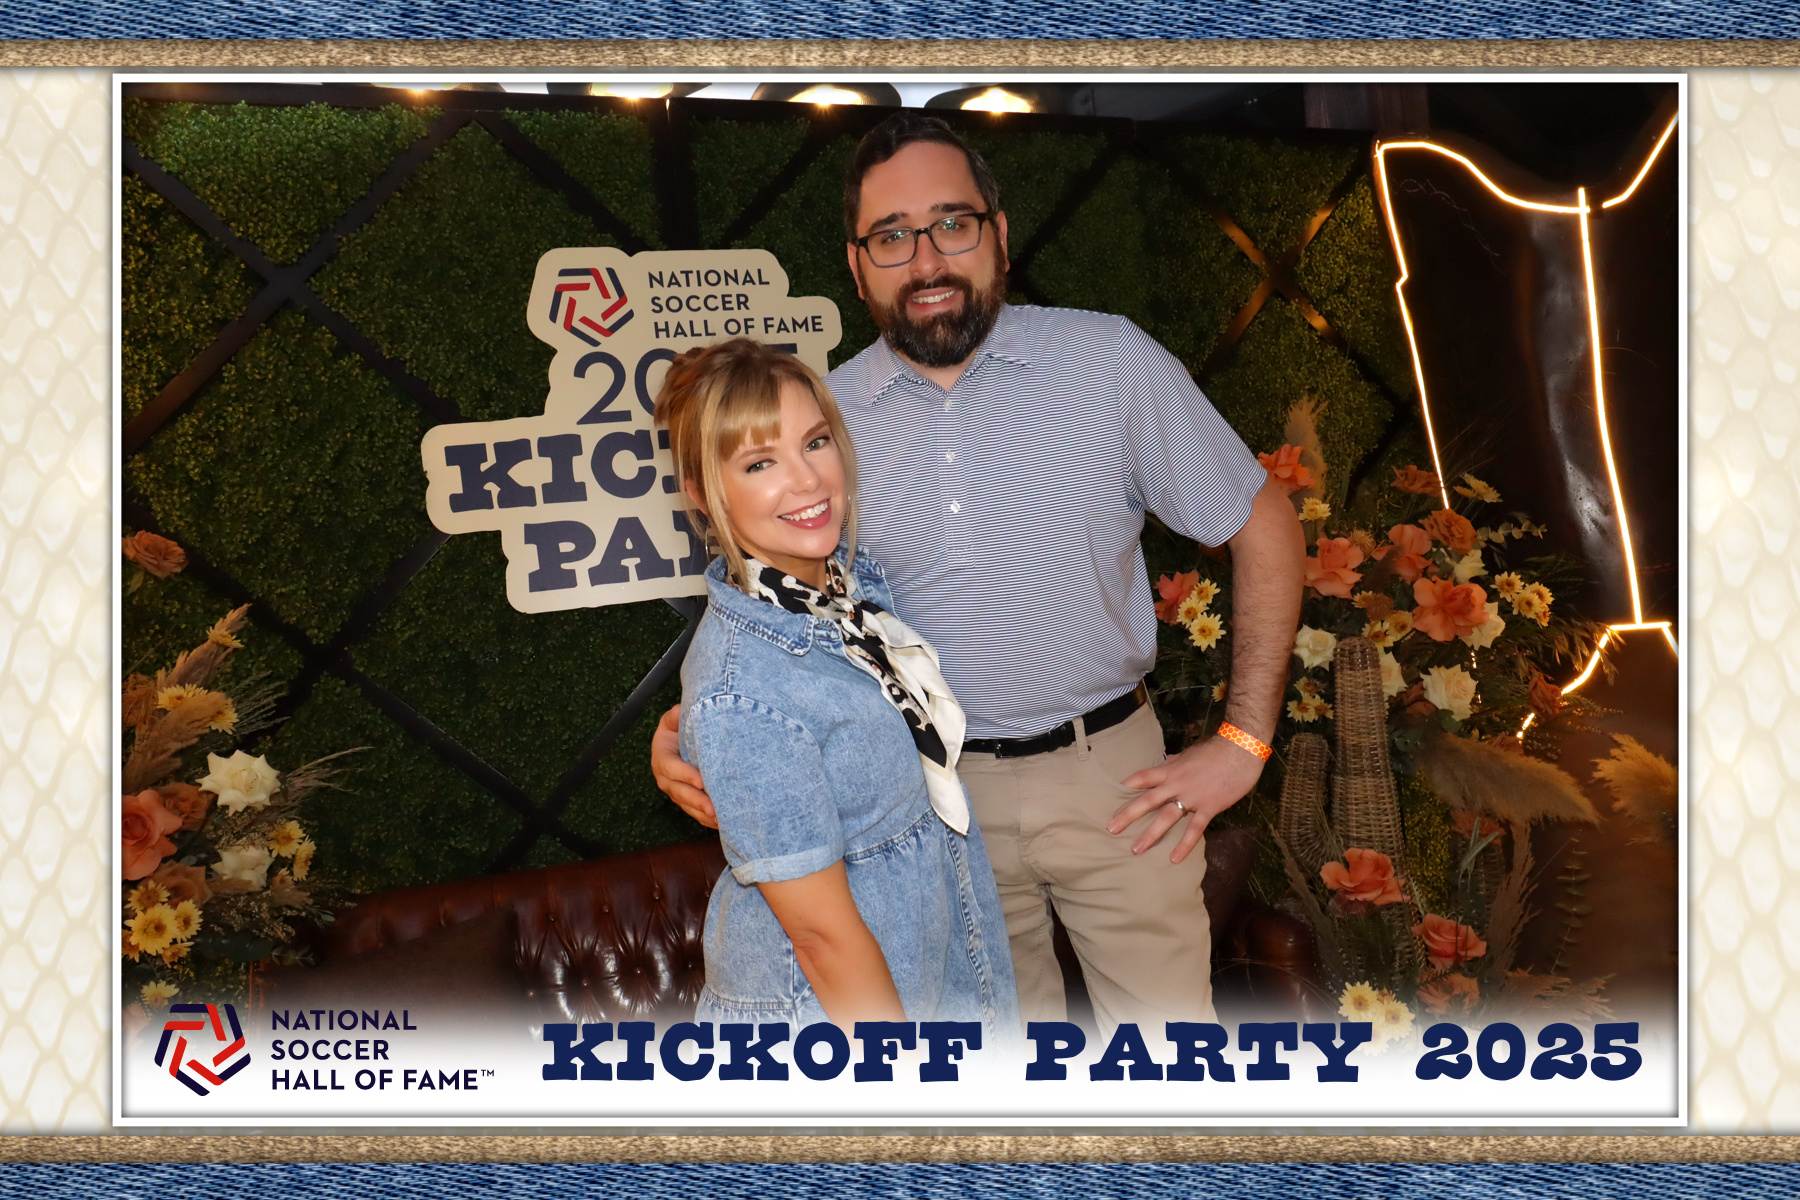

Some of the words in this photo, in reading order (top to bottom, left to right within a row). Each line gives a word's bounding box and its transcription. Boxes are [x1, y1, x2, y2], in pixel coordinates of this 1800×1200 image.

[648, 268, 770, 288] NATIONAL
[650, 293, 750, 314] SOCCER
[654, 319, 717, 339] HALL
[724, 317, 755, 336] OF
[763, 315, 824, 334] FAME
